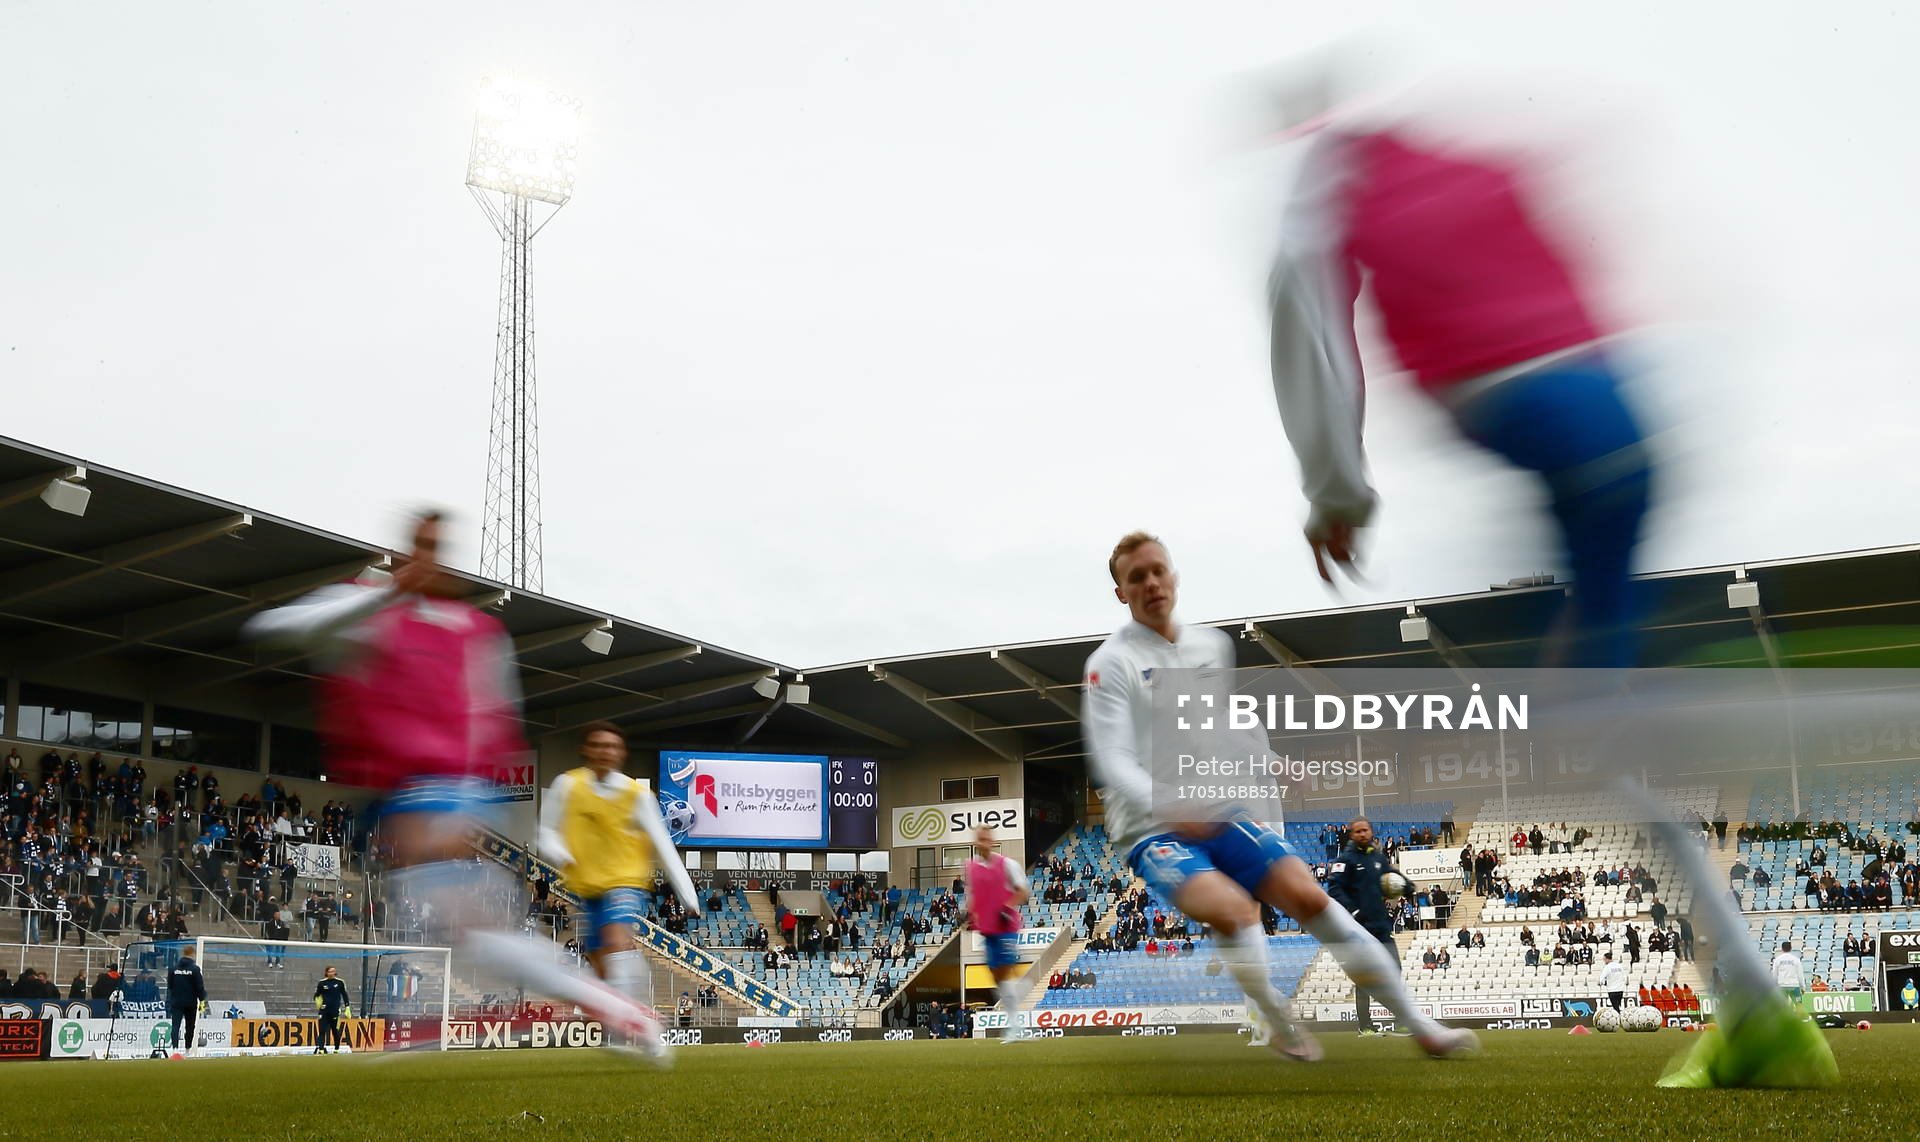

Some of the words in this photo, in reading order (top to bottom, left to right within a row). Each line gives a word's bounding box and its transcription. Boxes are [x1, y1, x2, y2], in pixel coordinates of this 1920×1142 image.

[832, 761, 843, 769] IFK
[863, 762, 875, 770] KFF
[1419, 749, 1519, 783] 1945
[488, 765, 535, 788] AXI
[834, 770, 843, 785] 0
[864, 771, 873, 786] 0
[721, 783, 817, 802] Riksbyggen
[834, 792, 874, 808] 00:00
[735, 800, 757, 813] Rum
[760, 802, 771, 814] för
[773, 802, 792, 812] hela
[793, 802, 817, 812] livet
[951, 810, 1017, 832] suez
[728, 870, 797, 880] VENTILATIONS
[810, 870, 878, 880] VENTILATINS
[1018, 932, 1057, 945] LERS
[1889, 934, 1920, 947] ex
[121, 1001, 166, 1011] GRUPPO
[1444, 1006, 1490, 1015] STENBERGS
[1492, 1006, 1501, 1014] EL
[1503, 1006, 1514, 1014] AB
[1813, 996, 1855, 1012] OCAY!
[88, 1031, 138, 1044] Lundbergs
[480, 1021, 602, 1048] XL-BYGG
[0, 1043, 34, 1051] TEM
